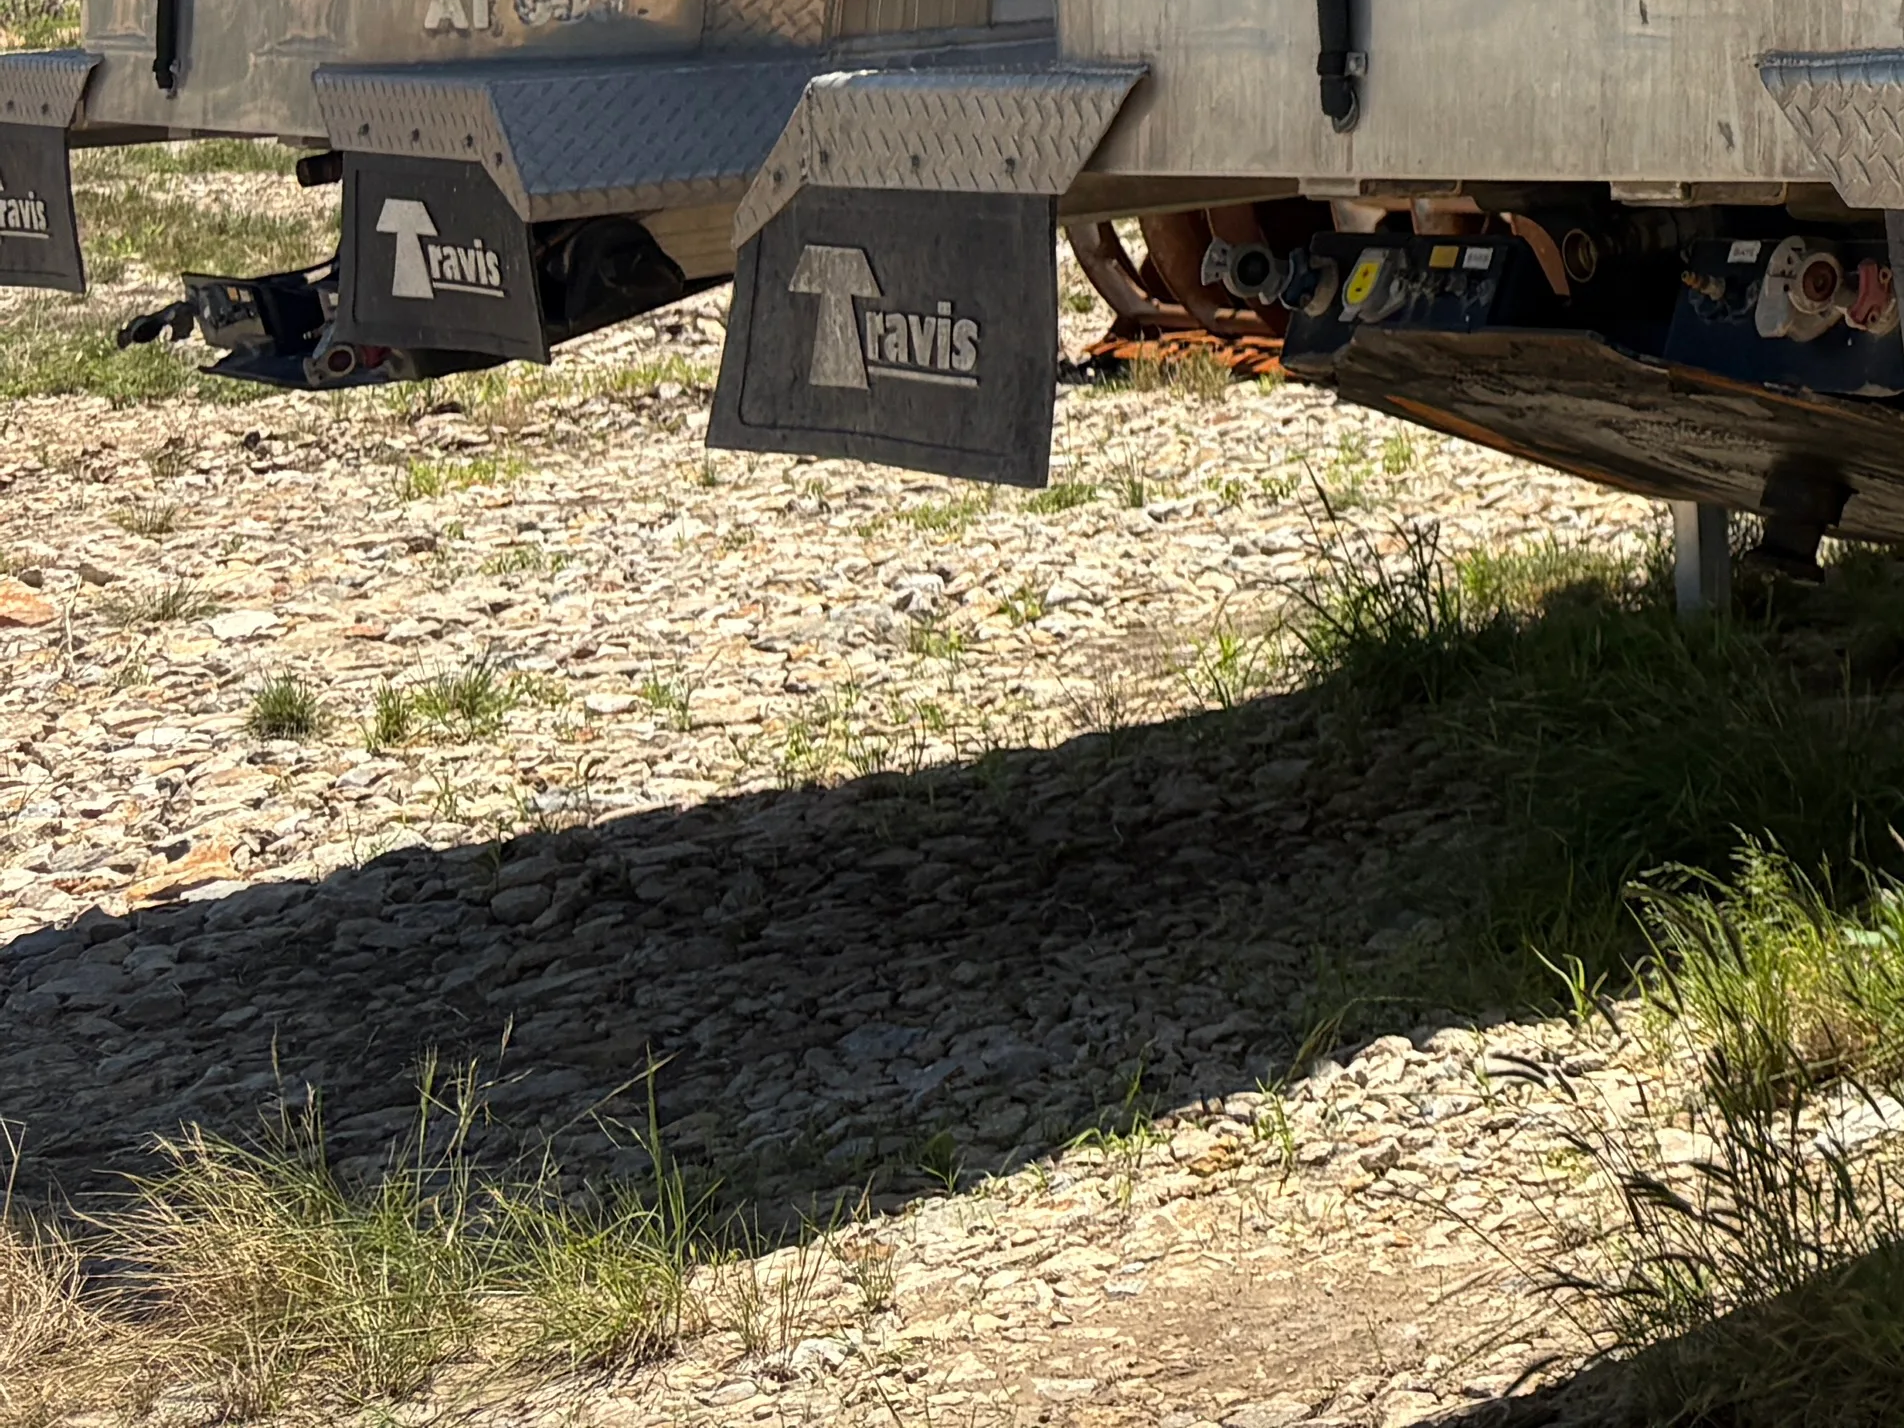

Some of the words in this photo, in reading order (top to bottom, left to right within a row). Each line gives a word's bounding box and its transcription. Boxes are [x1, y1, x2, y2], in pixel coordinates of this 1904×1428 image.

[0, 180, 47, 231] ravis
[376, 198, 501, 299] Travis
[788, 244, 981, 390] Travis
